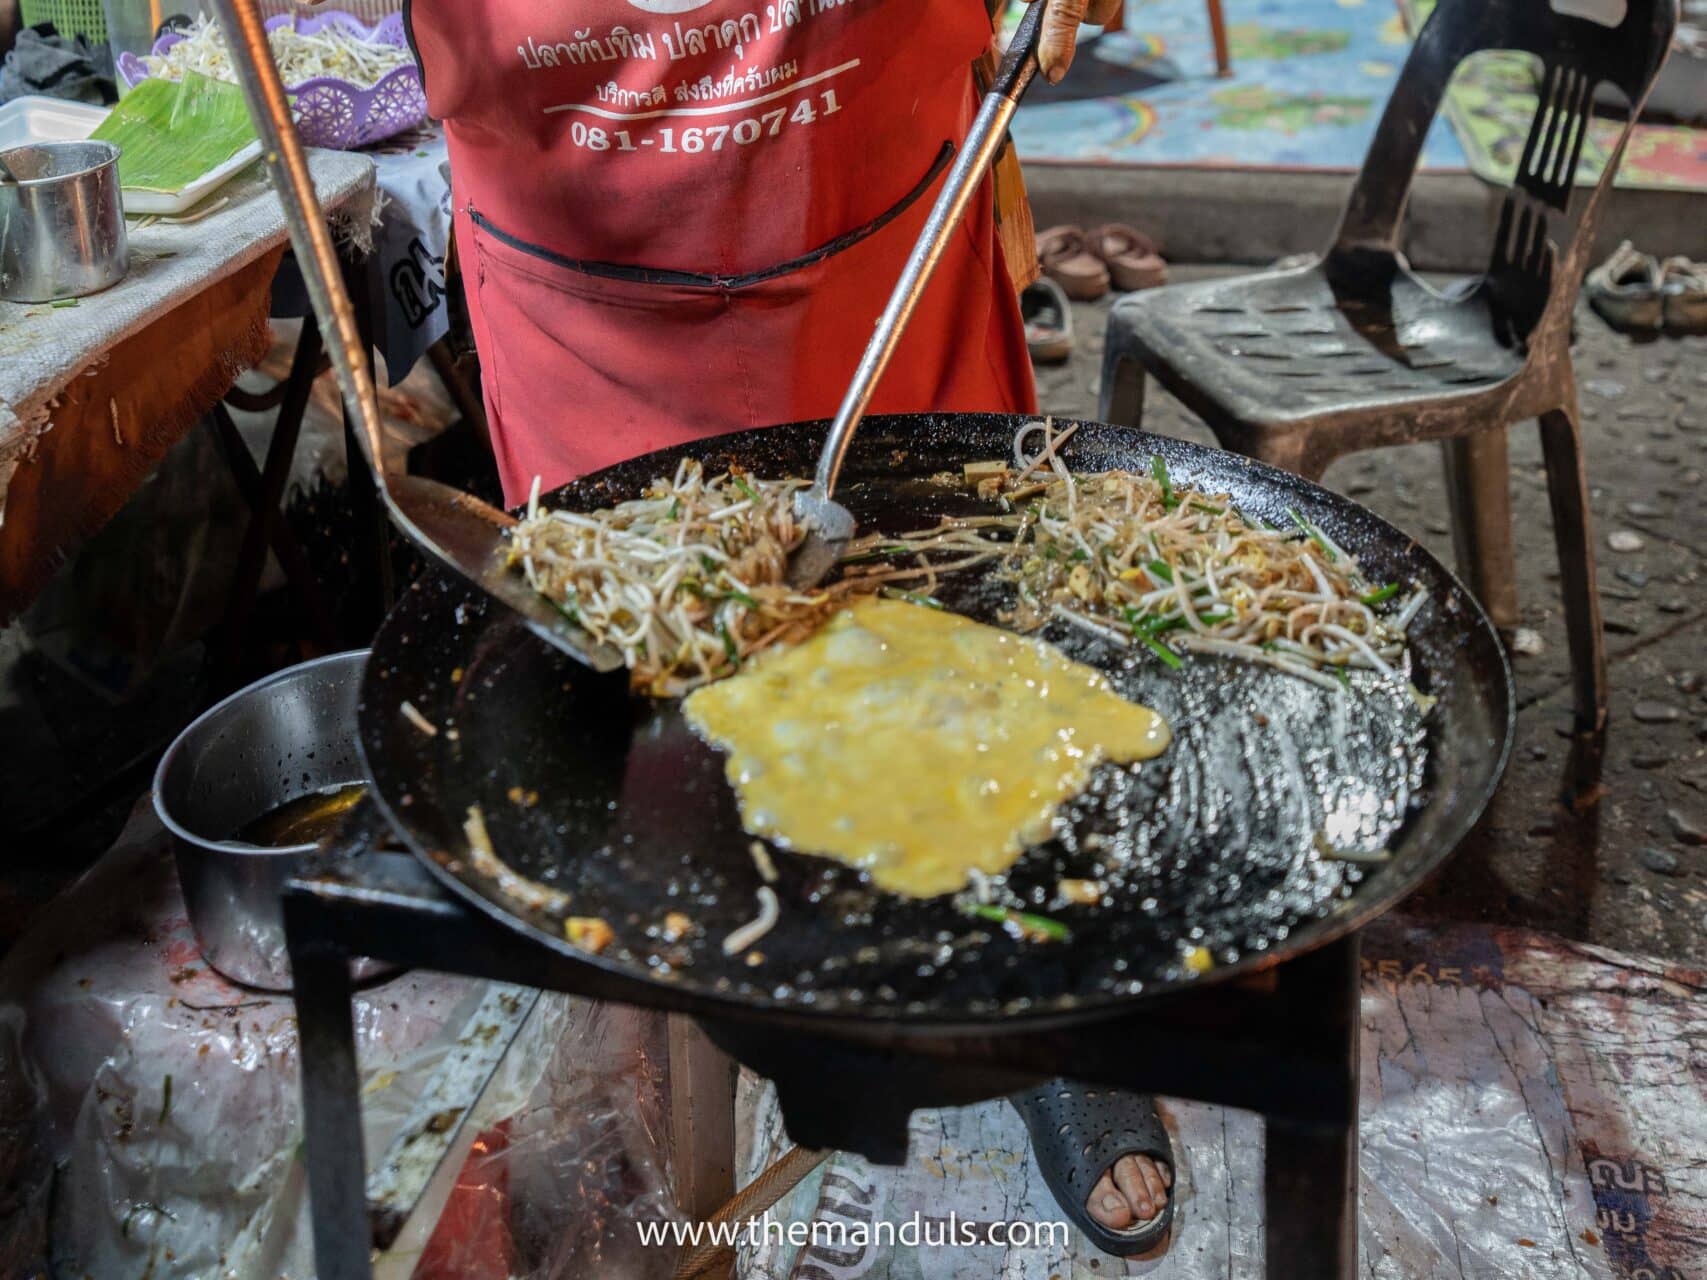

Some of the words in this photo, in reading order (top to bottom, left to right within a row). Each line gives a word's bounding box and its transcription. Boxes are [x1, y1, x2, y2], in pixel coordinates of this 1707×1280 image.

[517, 25, 657, 70] ปลาทับทิม
[662, 12, 761, 62] ปลาดุก
[570, 88, 843, 153] 081-1670741
[595, 80, 667, 108] บริการดี
